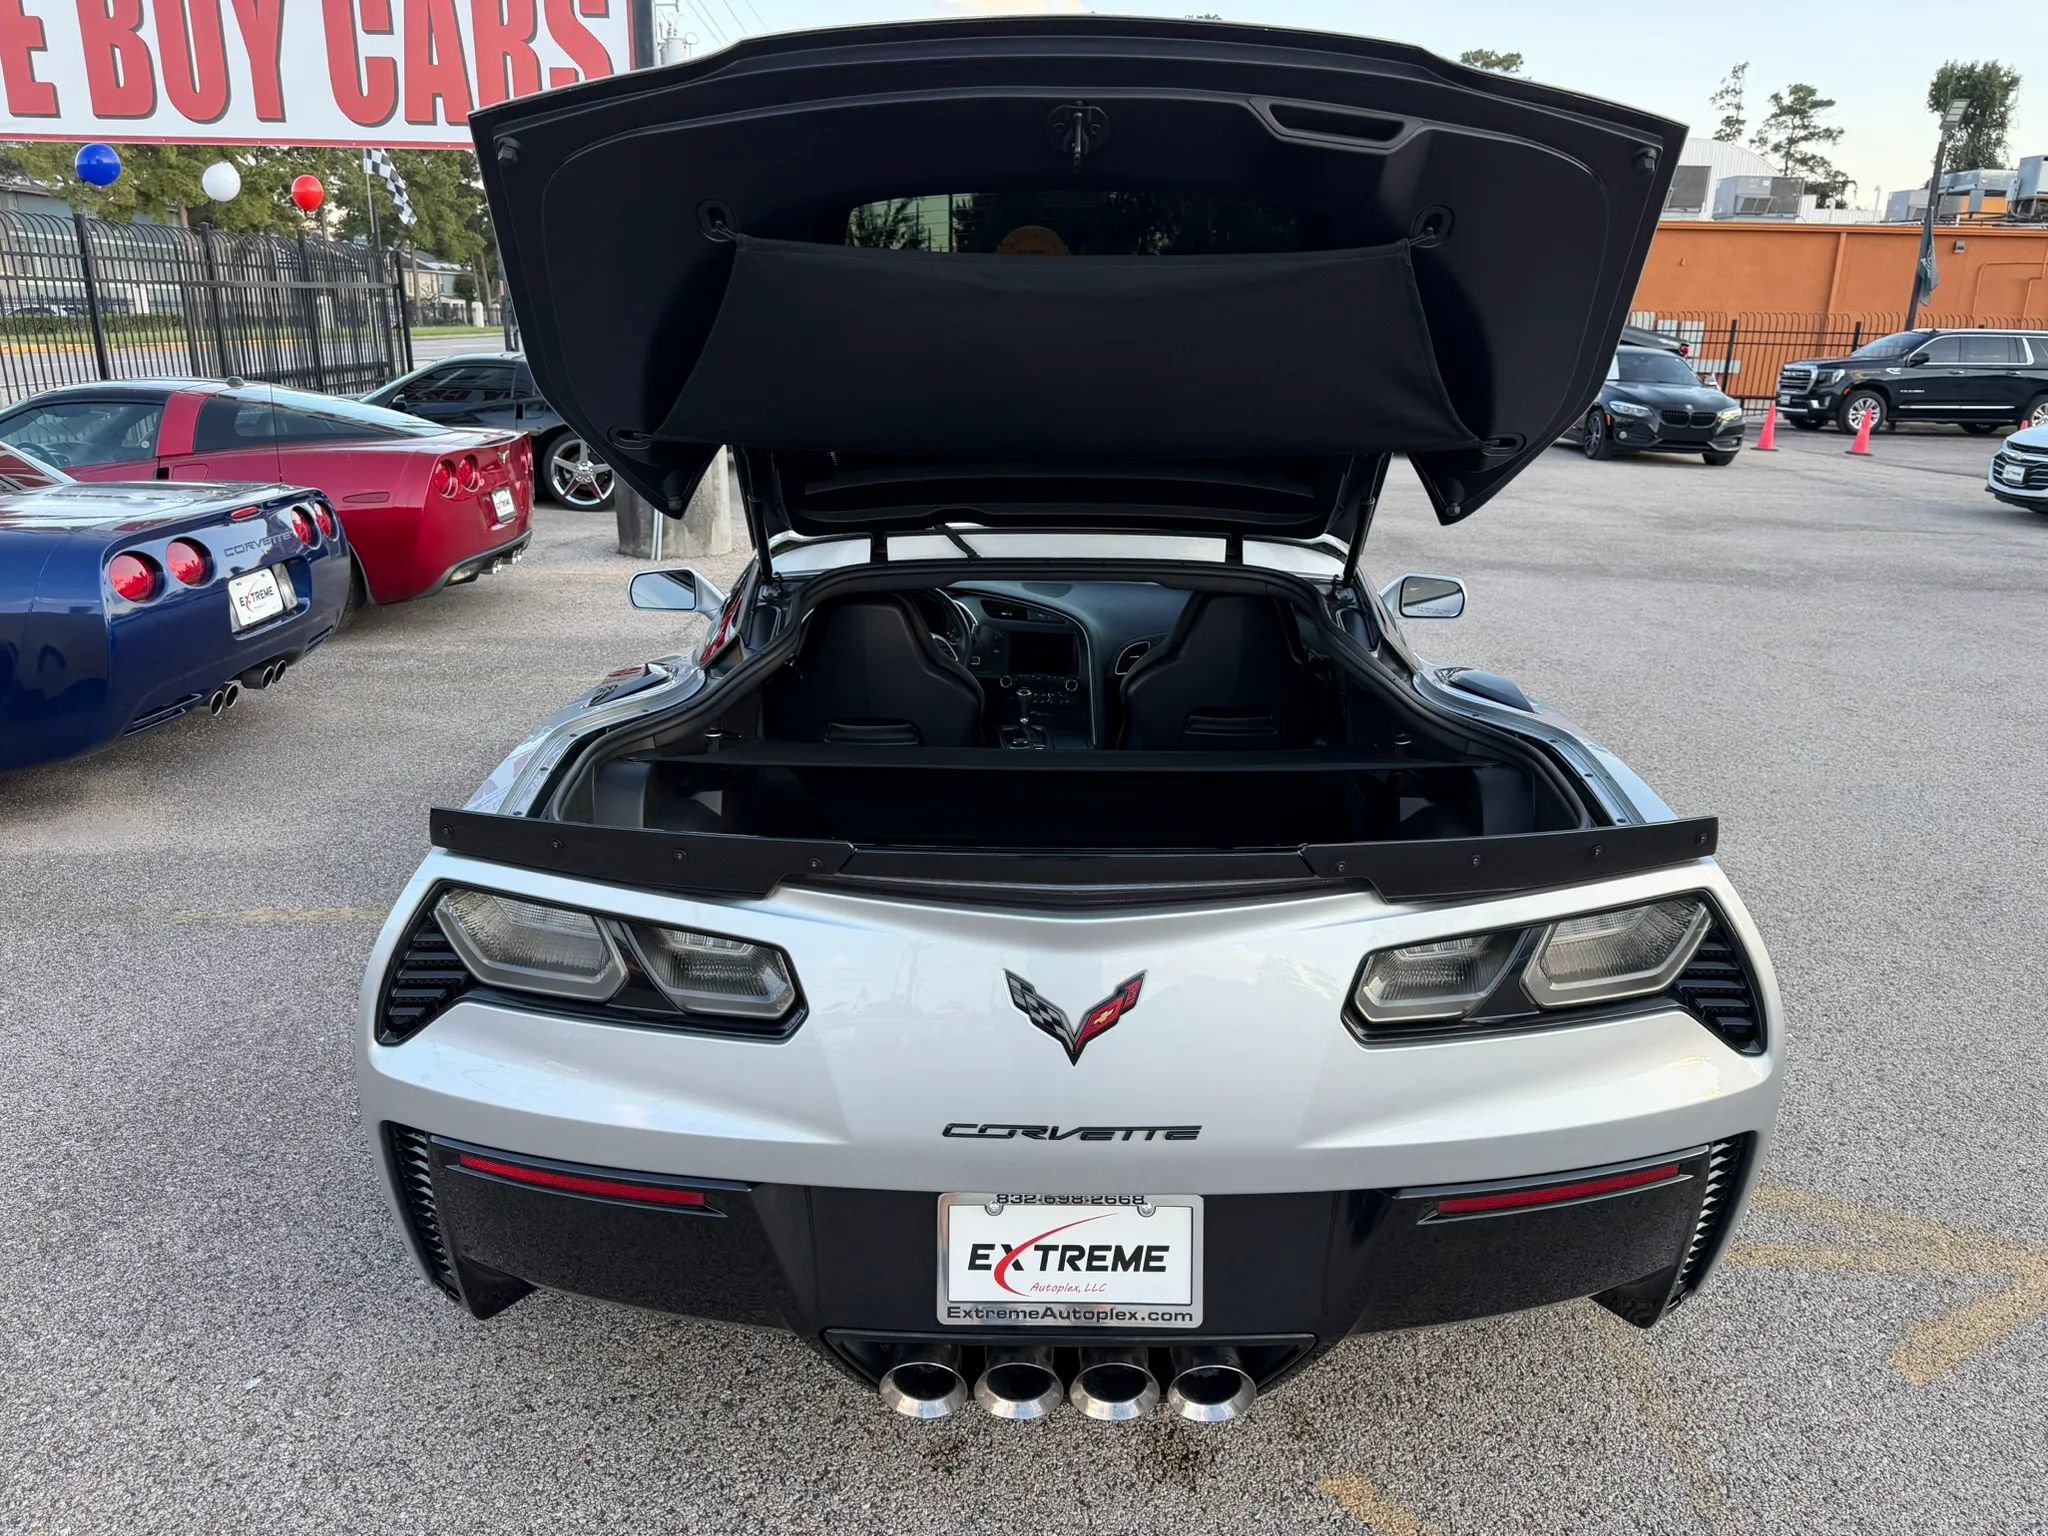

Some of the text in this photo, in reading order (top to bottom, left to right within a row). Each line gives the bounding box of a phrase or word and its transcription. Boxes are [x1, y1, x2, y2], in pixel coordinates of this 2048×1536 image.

[76, 0, 286, 123] BUY
[320, 0, 615, 126] CARS
[224, 531, 292, 557] CORVETTE
[239, 586, 274, 607] EXTREME
[942, 1123, 1203, 1141] CORVETTE
[967, 1243, 1170, 1273] EXTREME
[1030, 1282, 1107, 1294] Autoplex, LLC
[946, 1306, 1193, 1324] ExtremeAutoplex.com
